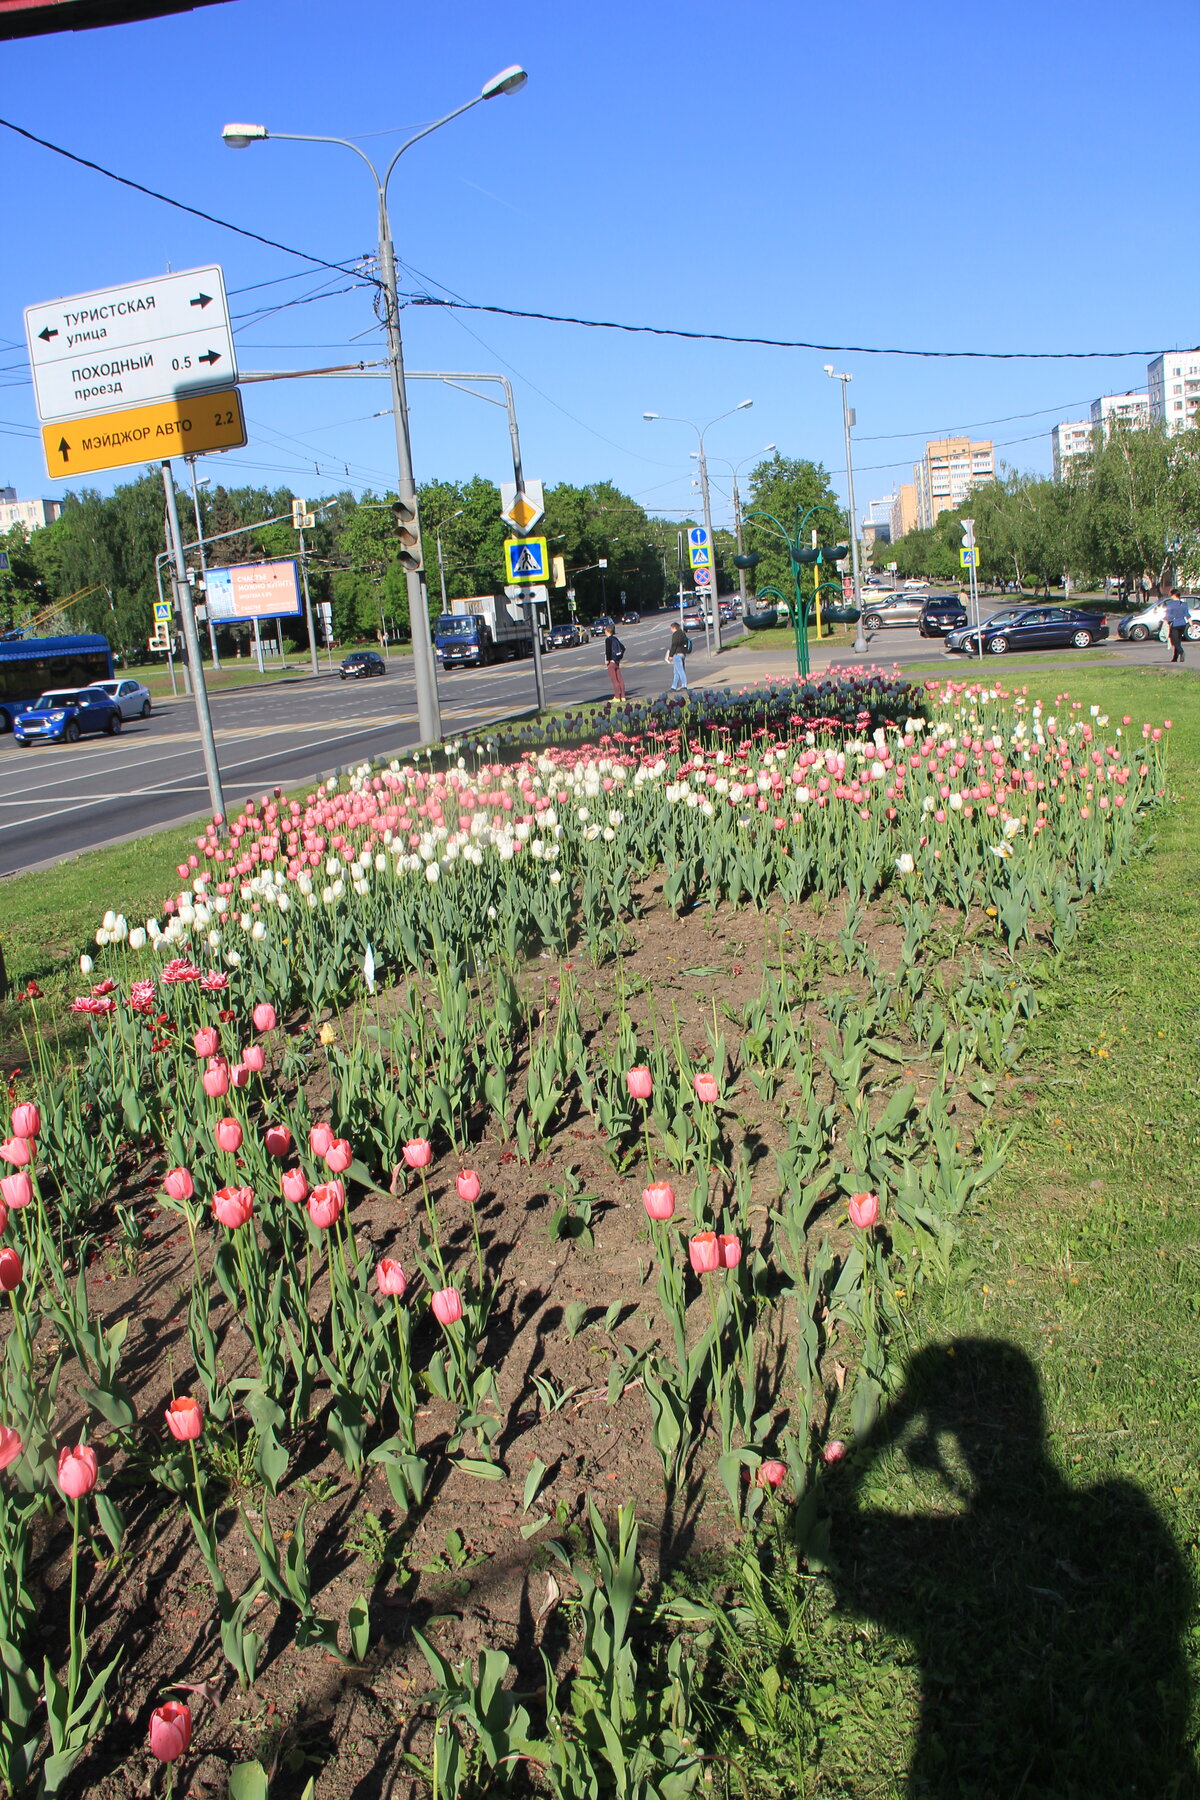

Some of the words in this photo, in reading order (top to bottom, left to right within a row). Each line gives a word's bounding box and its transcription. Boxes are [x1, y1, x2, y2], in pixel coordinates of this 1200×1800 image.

[63, 296, 156, 327] ТУРИСТСКАЯ
[66, 328, 107, 348] улица
[71, 352, 154, 383] ПОХОДНЫЙ
[171, 356, 192, 371] 0.5
[74, 382, 123, 401] проезд
[82, 427, 151, 451] МЭЙДЖОР
[155, 419, 193, 437] АВТО
[214, 411, 234, 426] 2.2
[238, 583, 266, 592] МОЖНО
